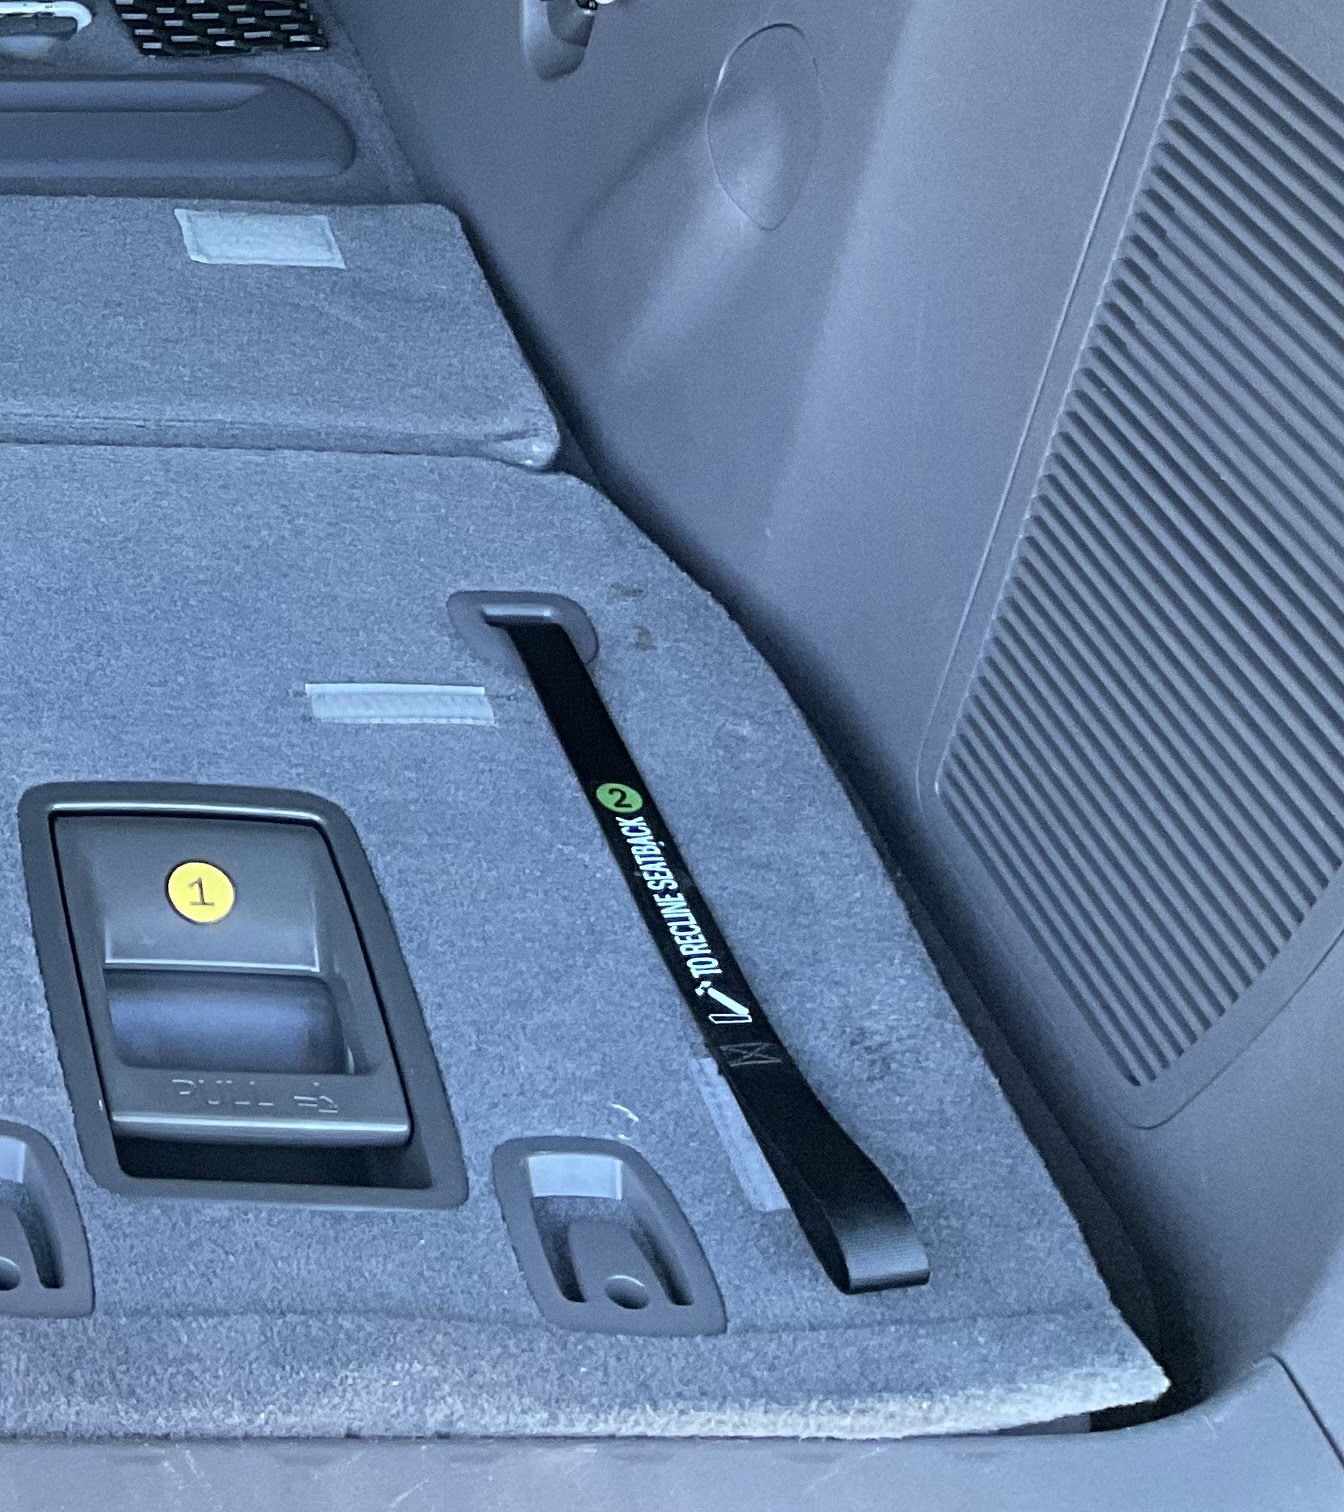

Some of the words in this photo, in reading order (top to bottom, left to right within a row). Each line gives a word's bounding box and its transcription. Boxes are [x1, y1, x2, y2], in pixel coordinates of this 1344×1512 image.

[608, 788, 633, 808] 2
[615, 816, 679, 891] SEATBACK
[188, 876, 215, 906] 1
[652, 892, 712, 956] RECLINE
[686, 956, 723, 979] TO
[172, 1078, 274, 1107] PULL
